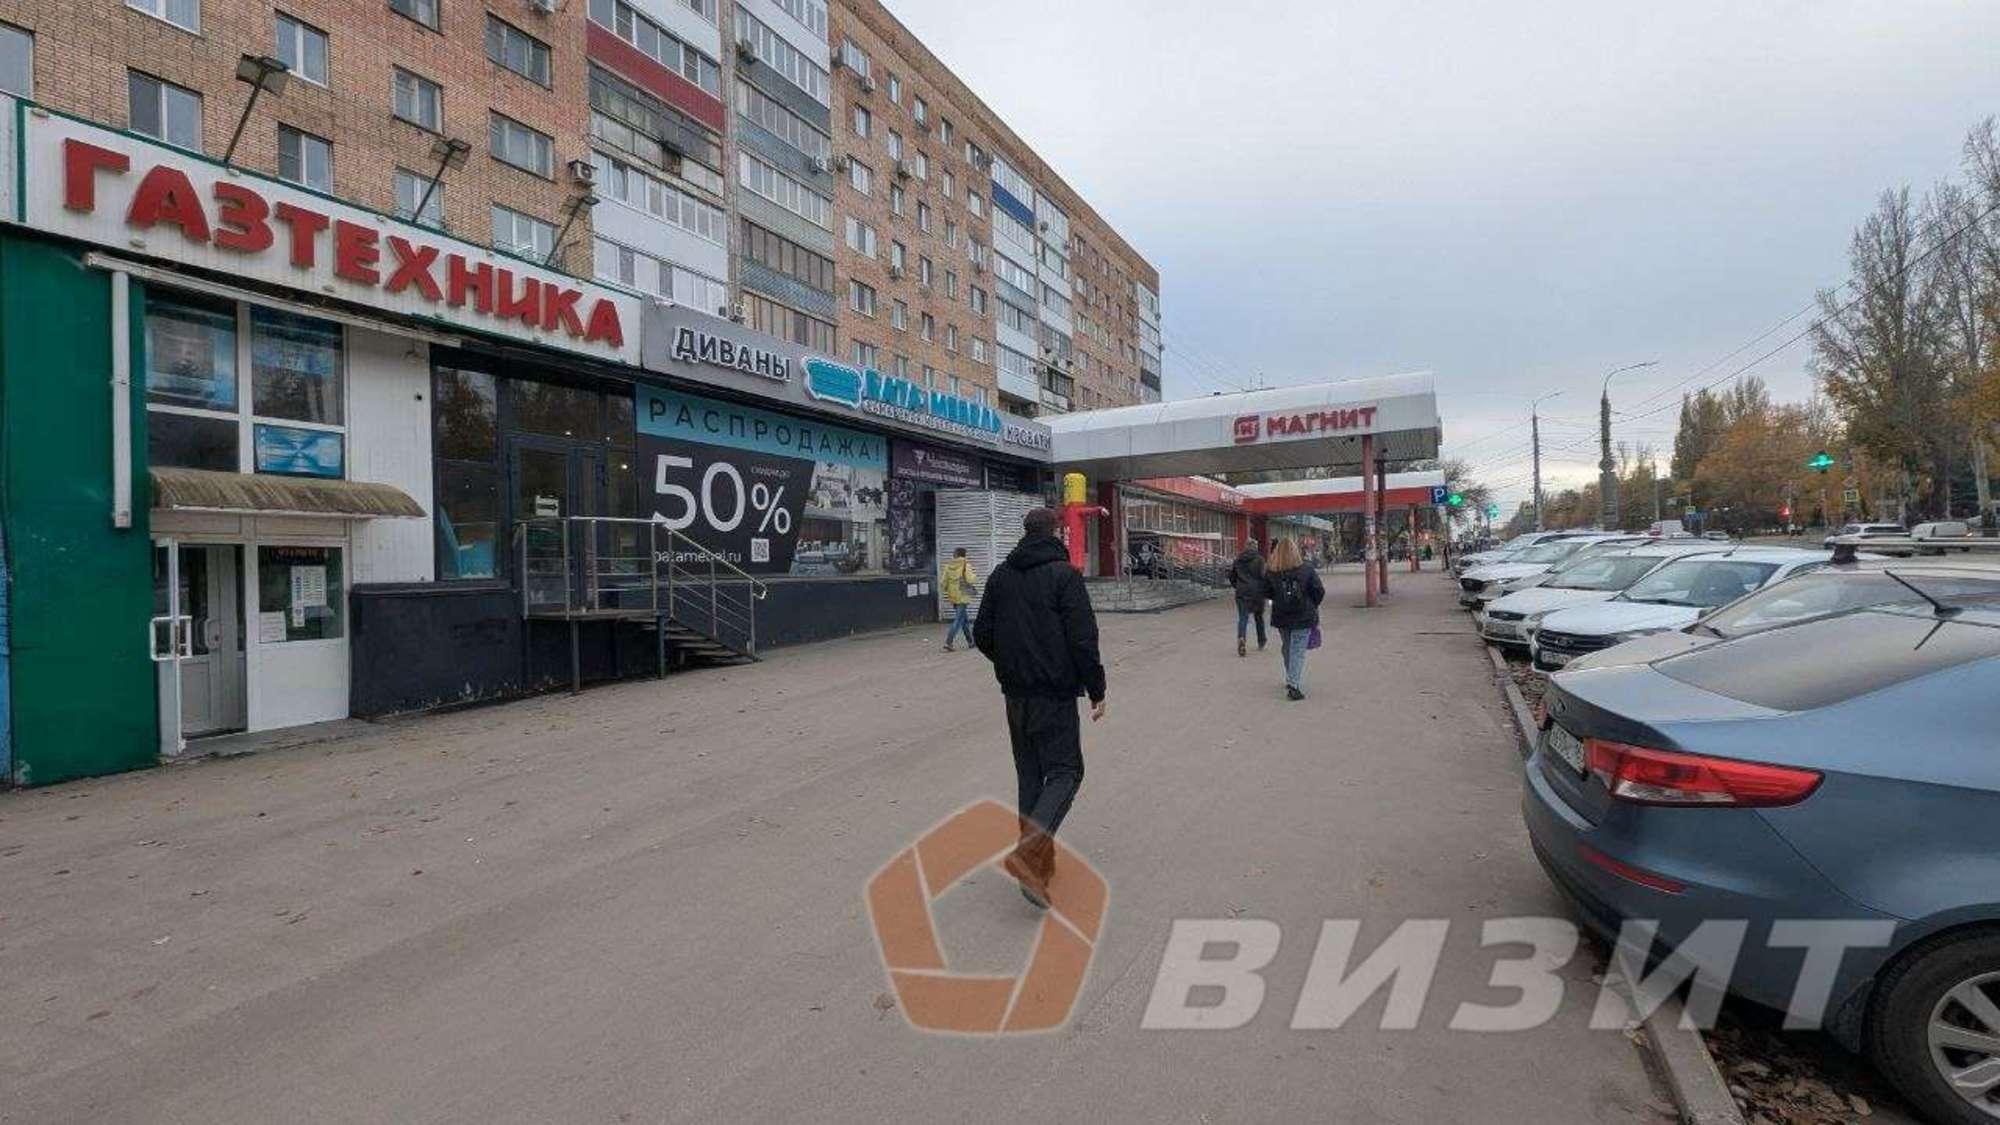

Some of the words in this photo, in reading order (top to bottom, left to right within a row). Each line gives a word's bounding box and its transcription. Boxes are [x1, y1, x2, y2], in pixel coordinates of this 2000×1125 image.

[63, 137, 624, 348] ГАЗТЕХНИКА
[671, 326, 792, 382] ДИВАНЫ
[650, 399, 882, 463] РАСПРОДАЖА!
[1266, 406, 1377, 436] МАГНИТ
[652, 454, 791, 535] 50%
[1433, 488, 1445, 503] P
